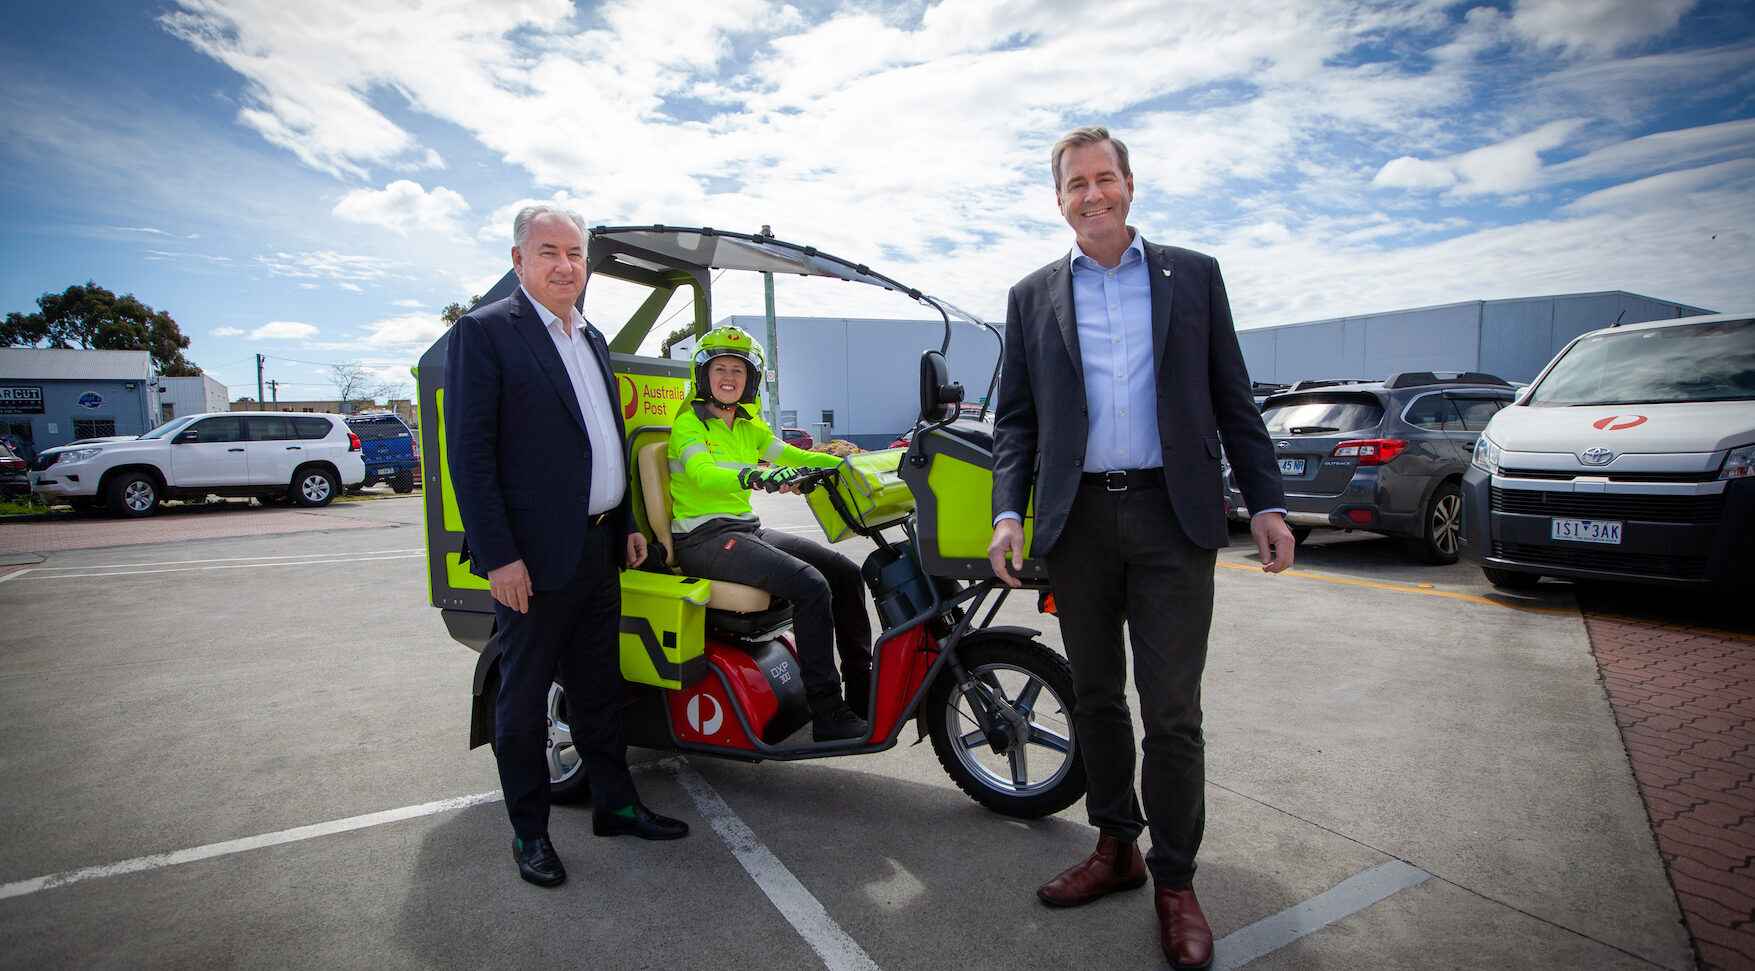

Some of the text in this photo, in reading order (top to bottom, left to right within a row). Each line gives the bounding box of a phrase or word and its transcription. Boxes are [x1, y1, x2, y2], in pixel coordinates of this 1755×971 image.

[15, 389, 38, 398] CUT
[643, 384, 685, 401] Australia
[644, 401, 667, 416] Post
[1592, 524, 1619, 539] 3AK
[770, 661, 788, 678] DXP
